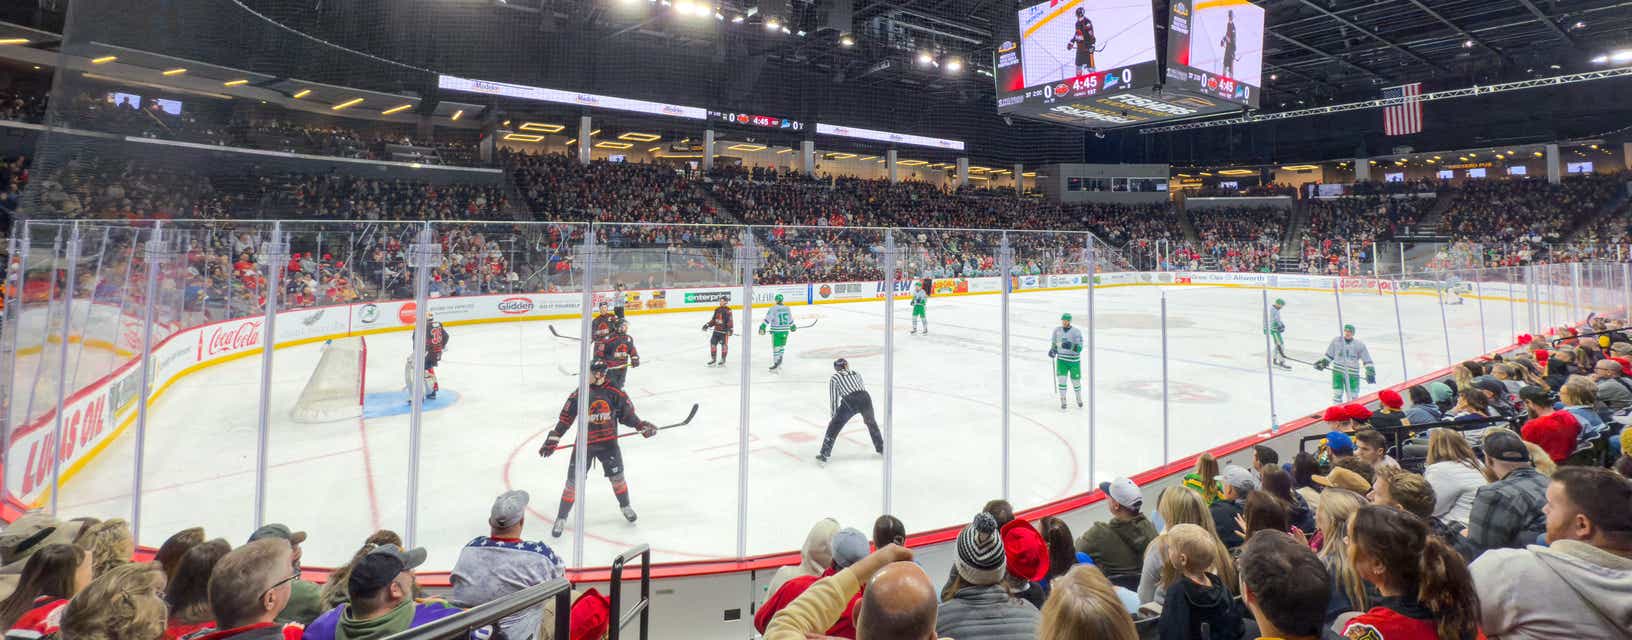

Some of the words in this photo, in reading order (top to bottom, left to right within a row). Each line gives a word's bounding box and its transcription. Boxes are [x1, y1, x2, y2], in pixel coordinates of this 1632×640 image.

[1073, 76, 1097, 90] 4:45
[1122, 69, 1132, 83] 0
[1201, 73, 1207, 88] 0
[1044, 85, 1052, 98] 0
[1218, 79, 1234, 93] 4:45
[1244, 86, 1250, 99] 0
[729, 113, 735, 122] 0
[753, 118, 769, 126] 4:45
[792, 121, 798, 130] 0
[498, 302, 534, 311] Glidden
[778, 313, 789, 326] 15
[80, 393, 105, 449] OIL
